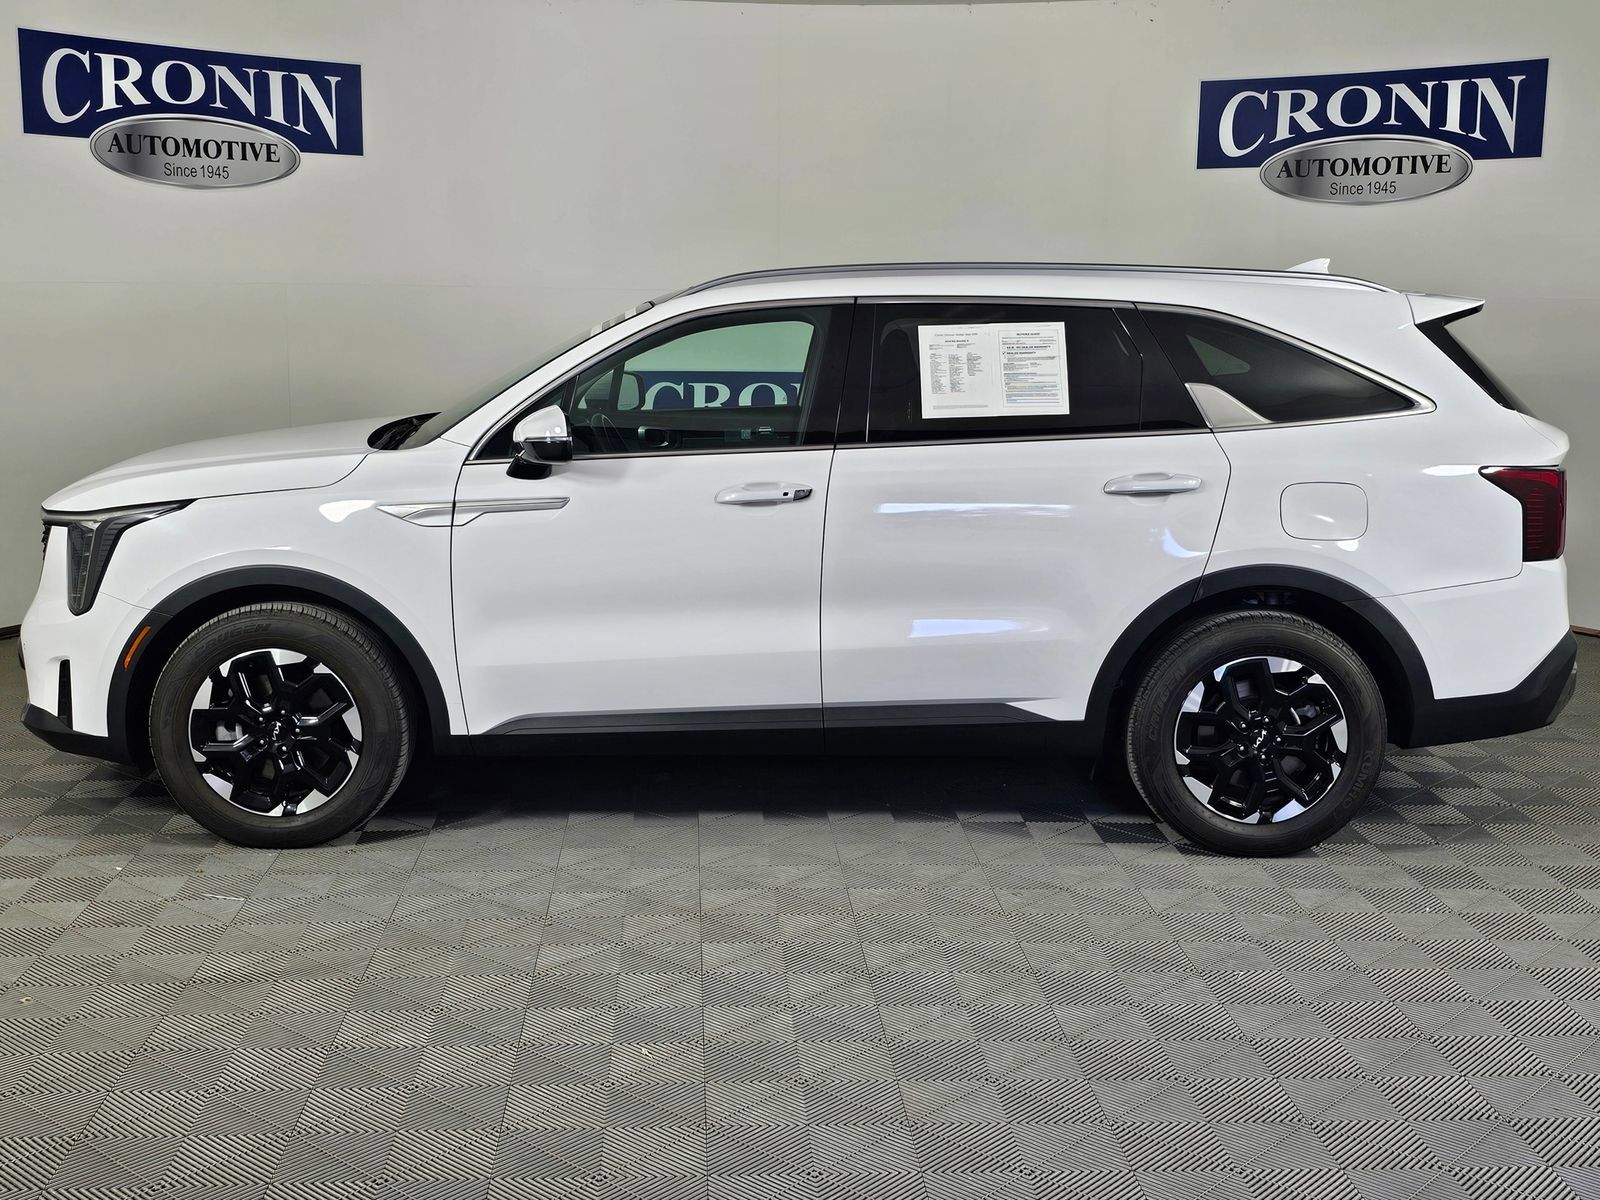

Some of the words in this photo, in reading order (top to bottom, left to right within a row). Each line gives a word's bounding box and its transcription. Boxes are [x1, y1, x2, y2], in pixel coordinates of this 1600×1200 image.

[42, 47, 342, 150] CRONIN
[1218, 75, 1526, 158] CRONIN
[107, 132, 281, 163] AUTOMOTIVE
[163, 162, 198, 178] Since
[200, 164, 230, 180] 1945
[1276, 154, 1452, 179] AUTOMOTIVE
[1329, 182, 1364, 196] Since
[1367, 180, 1397, 195] 1945
